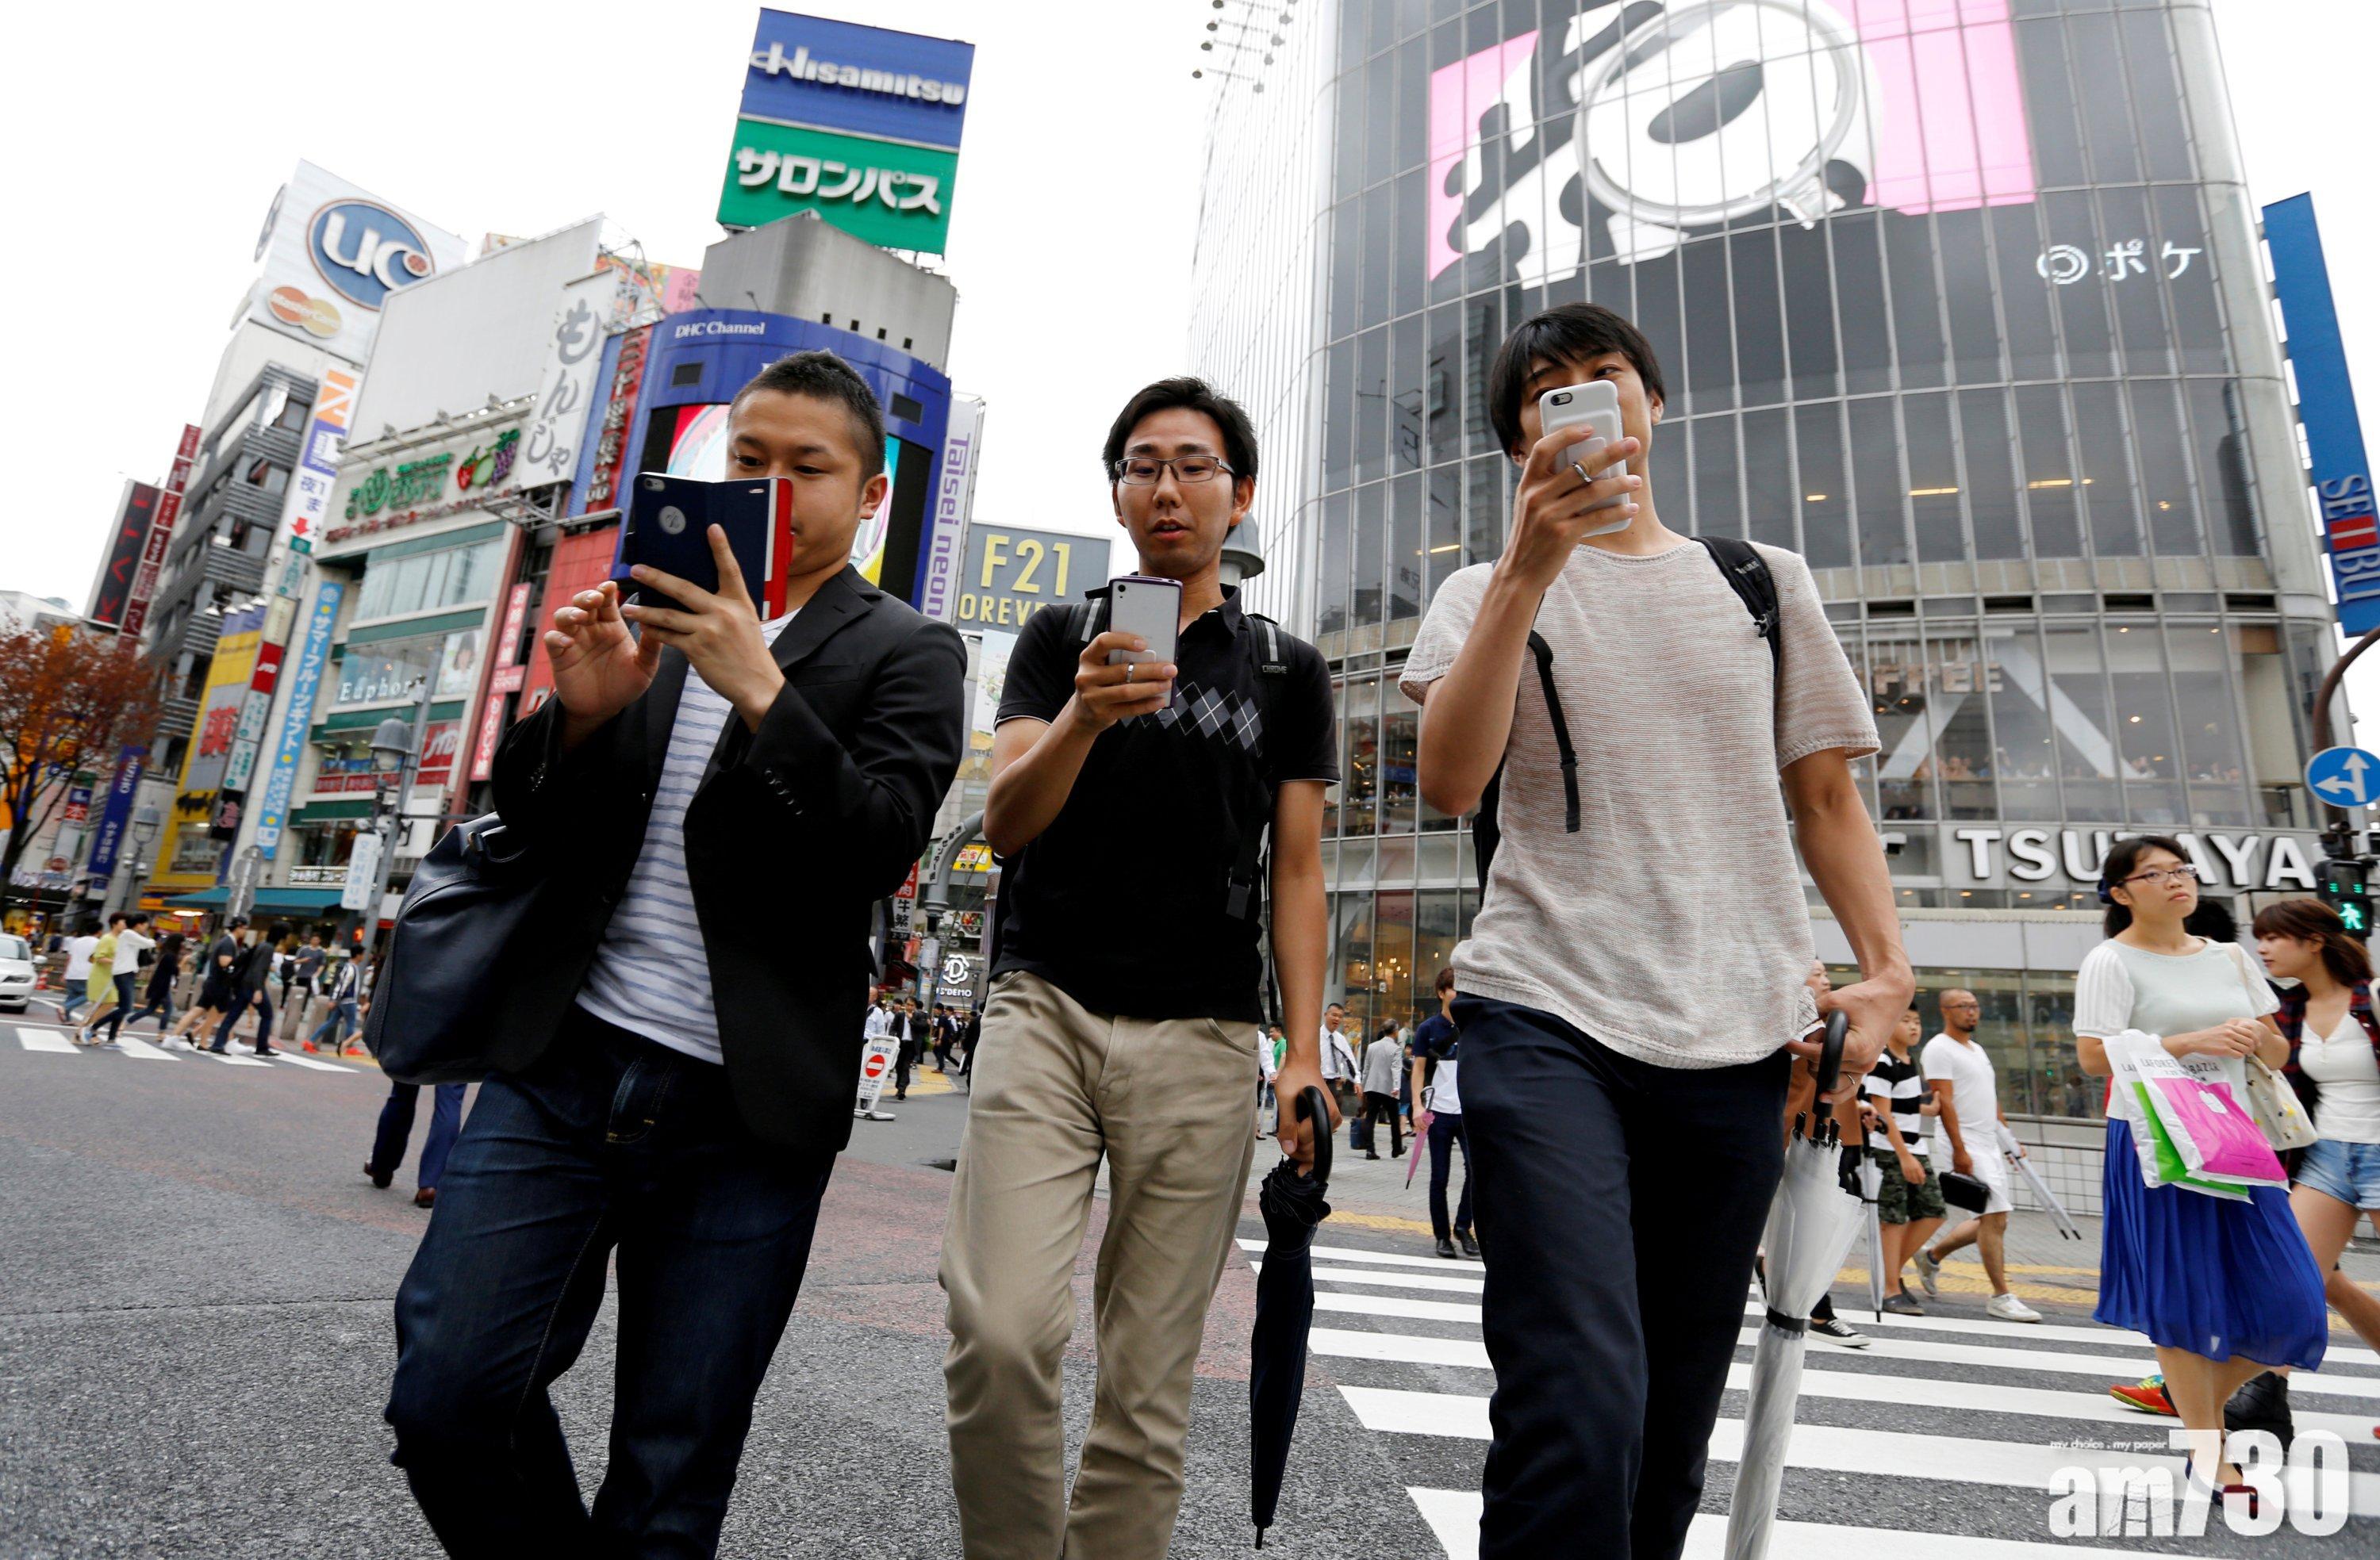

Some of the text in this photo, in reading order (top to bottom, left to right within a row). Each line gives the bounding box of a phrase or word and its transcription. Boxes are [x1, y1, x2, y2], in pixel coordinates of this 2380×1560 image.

[750, 42, 965, 105] Hisamitsu
[736, 147, 940, 215] サロンパス
[675, 321, 765, 339] DHC Channel
[927, 433, 969, 616] Taisei neon
[2321, 474, 2380, 602] SEIBU
[981, 534, 1070, 597] F21
[1854, 661, 2003, 695] FFEE
[1957, 830, 2317, 889] TSUAYA
